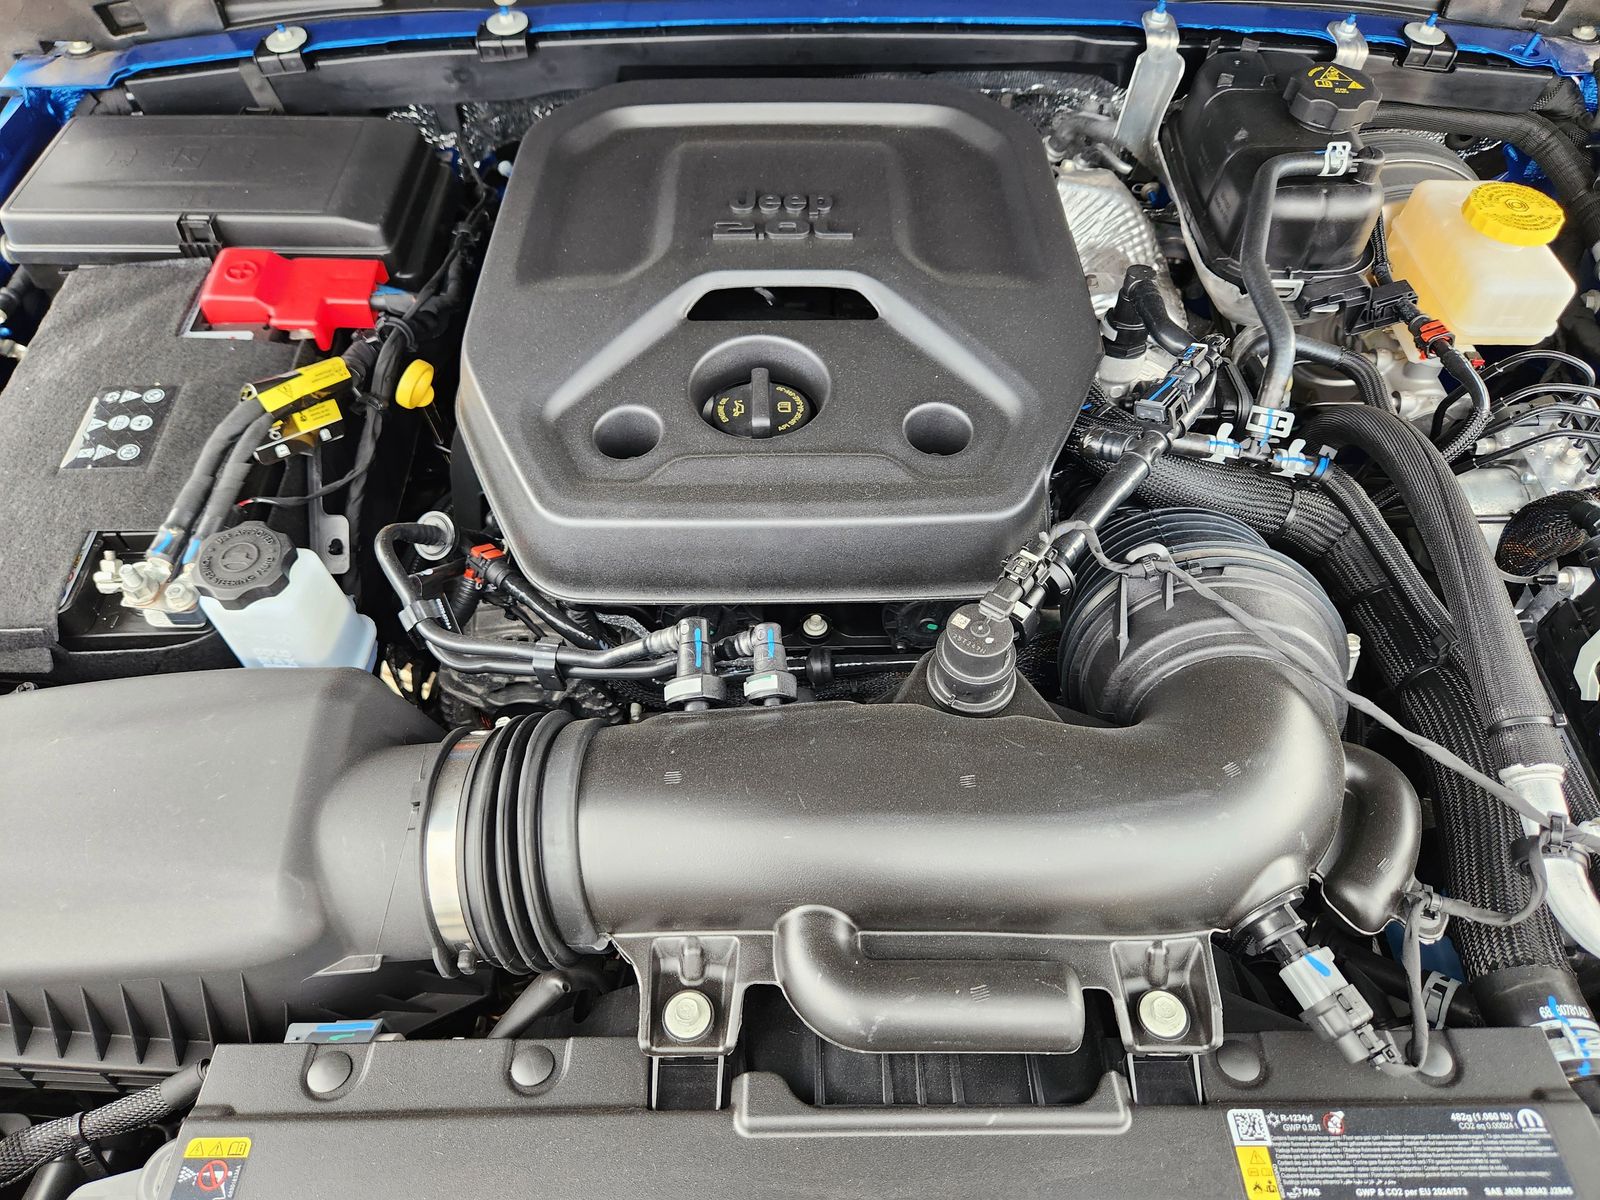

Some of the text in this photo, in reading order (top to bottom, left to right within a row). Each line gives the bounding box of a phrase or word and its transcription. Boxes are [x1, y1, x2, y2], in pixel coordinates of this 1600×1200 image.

[729, 190, 833, 218] Jeep
[713, 219, 854, 240] 2.0L
[1280, 1113, 1313, 1123] R-1234yf
[1282, 1124, 1321, 1132] GWP 0.501
[1458, 1122, 1475, 1130] CO2
[1302, 1188, 1321, 1197] PAG
[1356, 1188, 1375, 1197] GWP
[1377, 1188, 1384, 1196] &
[1385, 1188, 1403, 1197] CO2
[1404, 1188, 1418, 1198] per
[1419, 1187, 1431, 1196] EU
[1483, 1187, 1503, 1196] SAE
